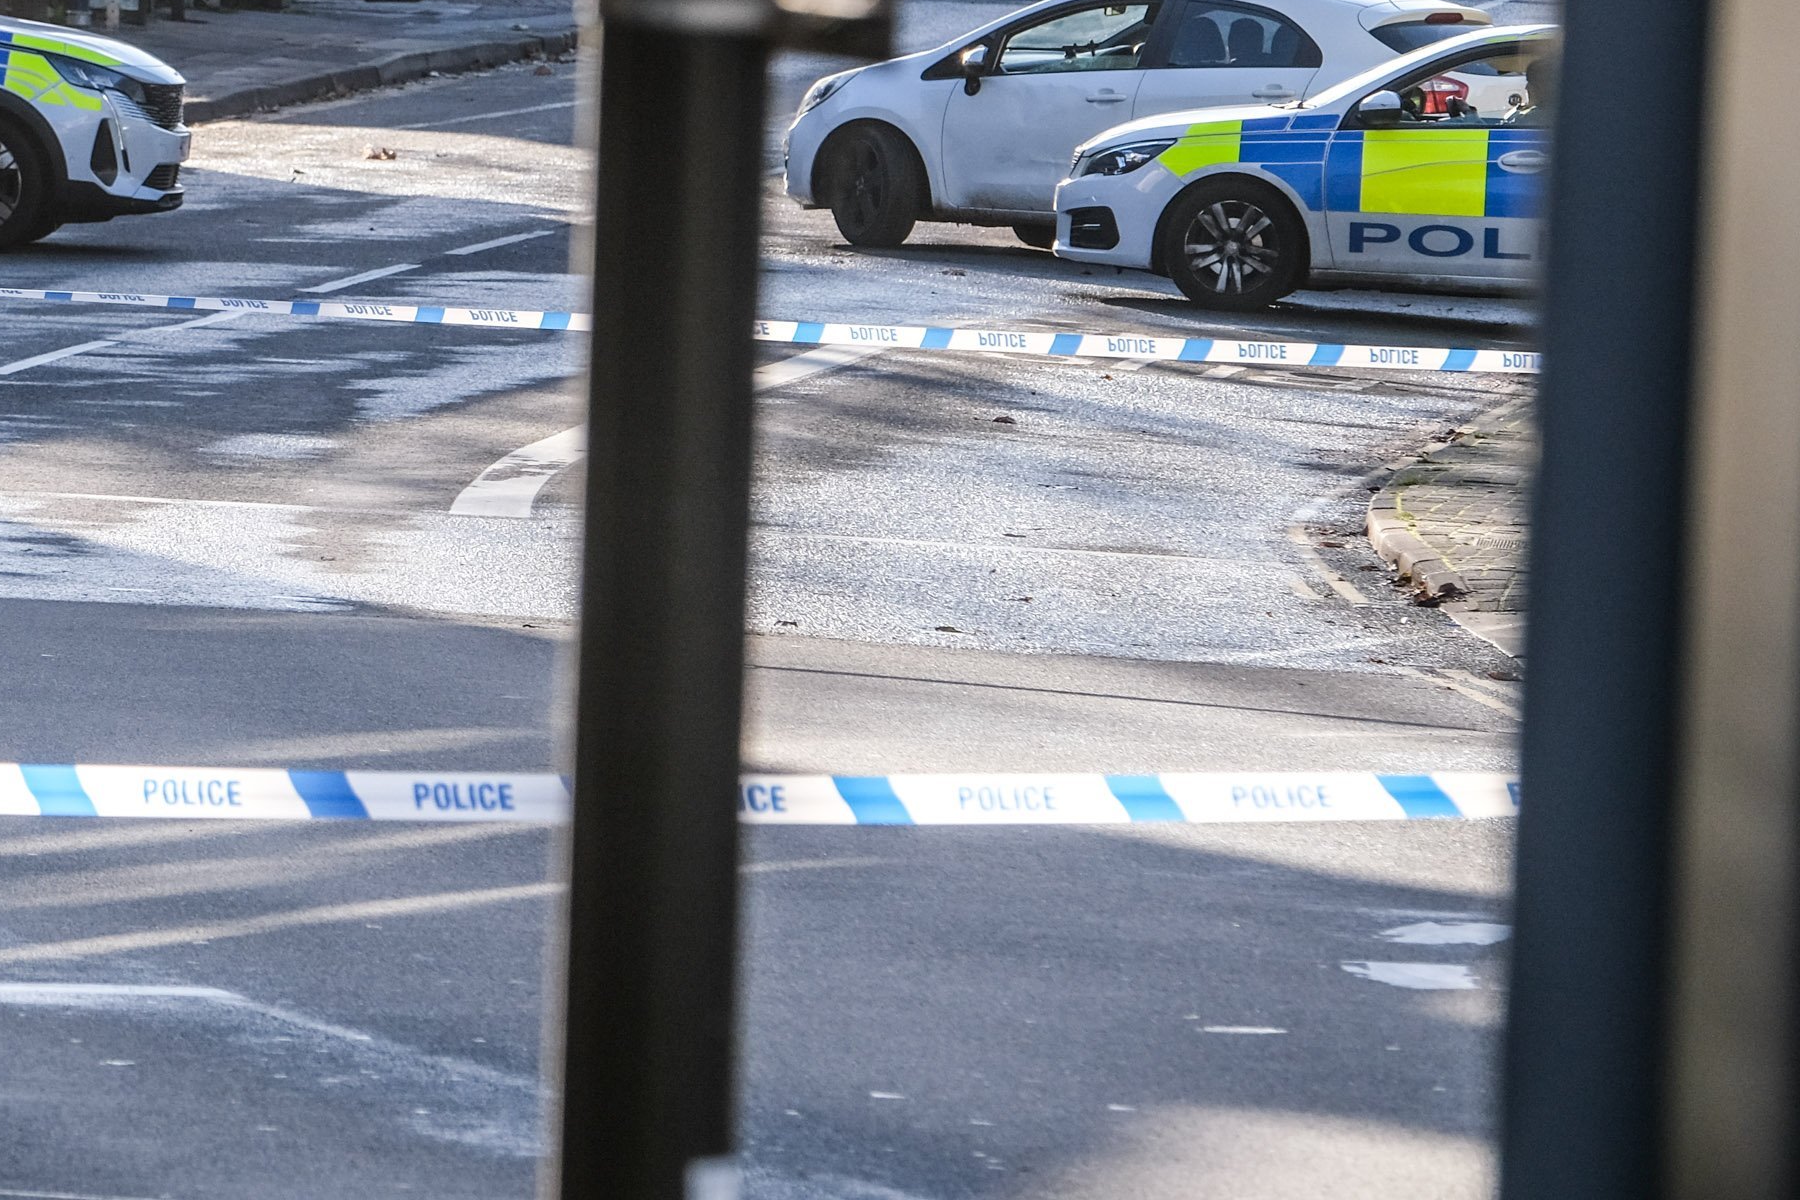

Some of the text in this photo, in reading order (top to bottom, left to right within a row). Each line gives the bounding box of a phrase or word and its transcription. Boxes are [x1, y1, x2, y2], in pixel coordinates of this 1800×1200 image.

[1349, 222, 1531, 260] POL
[142, 778, 242, 807] POLICE
[412, 781, 515, 812] POLICE
[959, 784, 1057, 811] POLICE
[1232, 784, 1332, 809] POLICE
